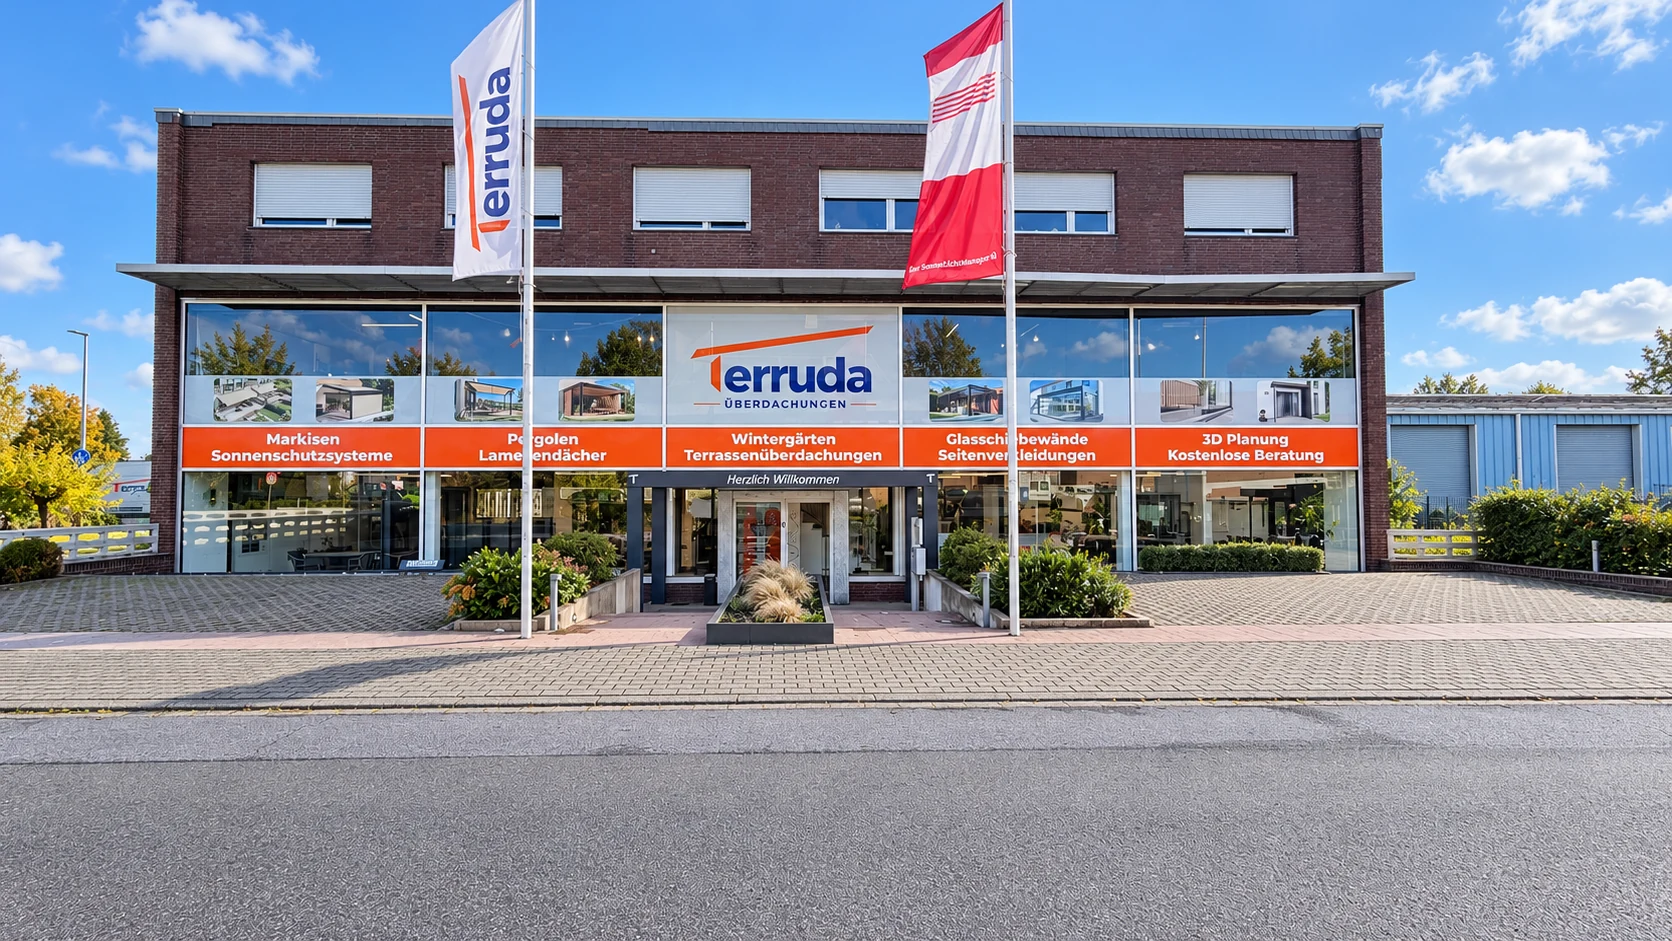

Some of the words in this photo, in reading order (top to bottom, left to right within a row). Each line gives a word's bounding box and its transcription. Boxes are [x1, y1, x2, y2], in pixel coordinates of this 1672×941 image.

[691, 325, 873, 394] Terruda
[724, 397, 846, 409] ÜBERDACHUNGEN
[266, 431, 340, 446] Markisen
[507, 432, 579, 448] Pegolen
[731, 432, 836, 448] Wintergärten
[946, 432, 1089, 446] Glasschibewände
[1202, 433, 1223, 445] 3D
[1226, 433, 1289, 448] Planung
[211, 448, 393, 464] Sonnenschutzsysteme
[479, 449, 607, 462] Lameendächer
[683, 448, 882, 464] Terrassenüberdachungen
[1168, 449, 1251, 461] Kostenlose
[1254, 449, 1324, 464] Beratung
[726, 474, 770, 485] Herzlich
[773, 474, 840, 485] Willkommen
